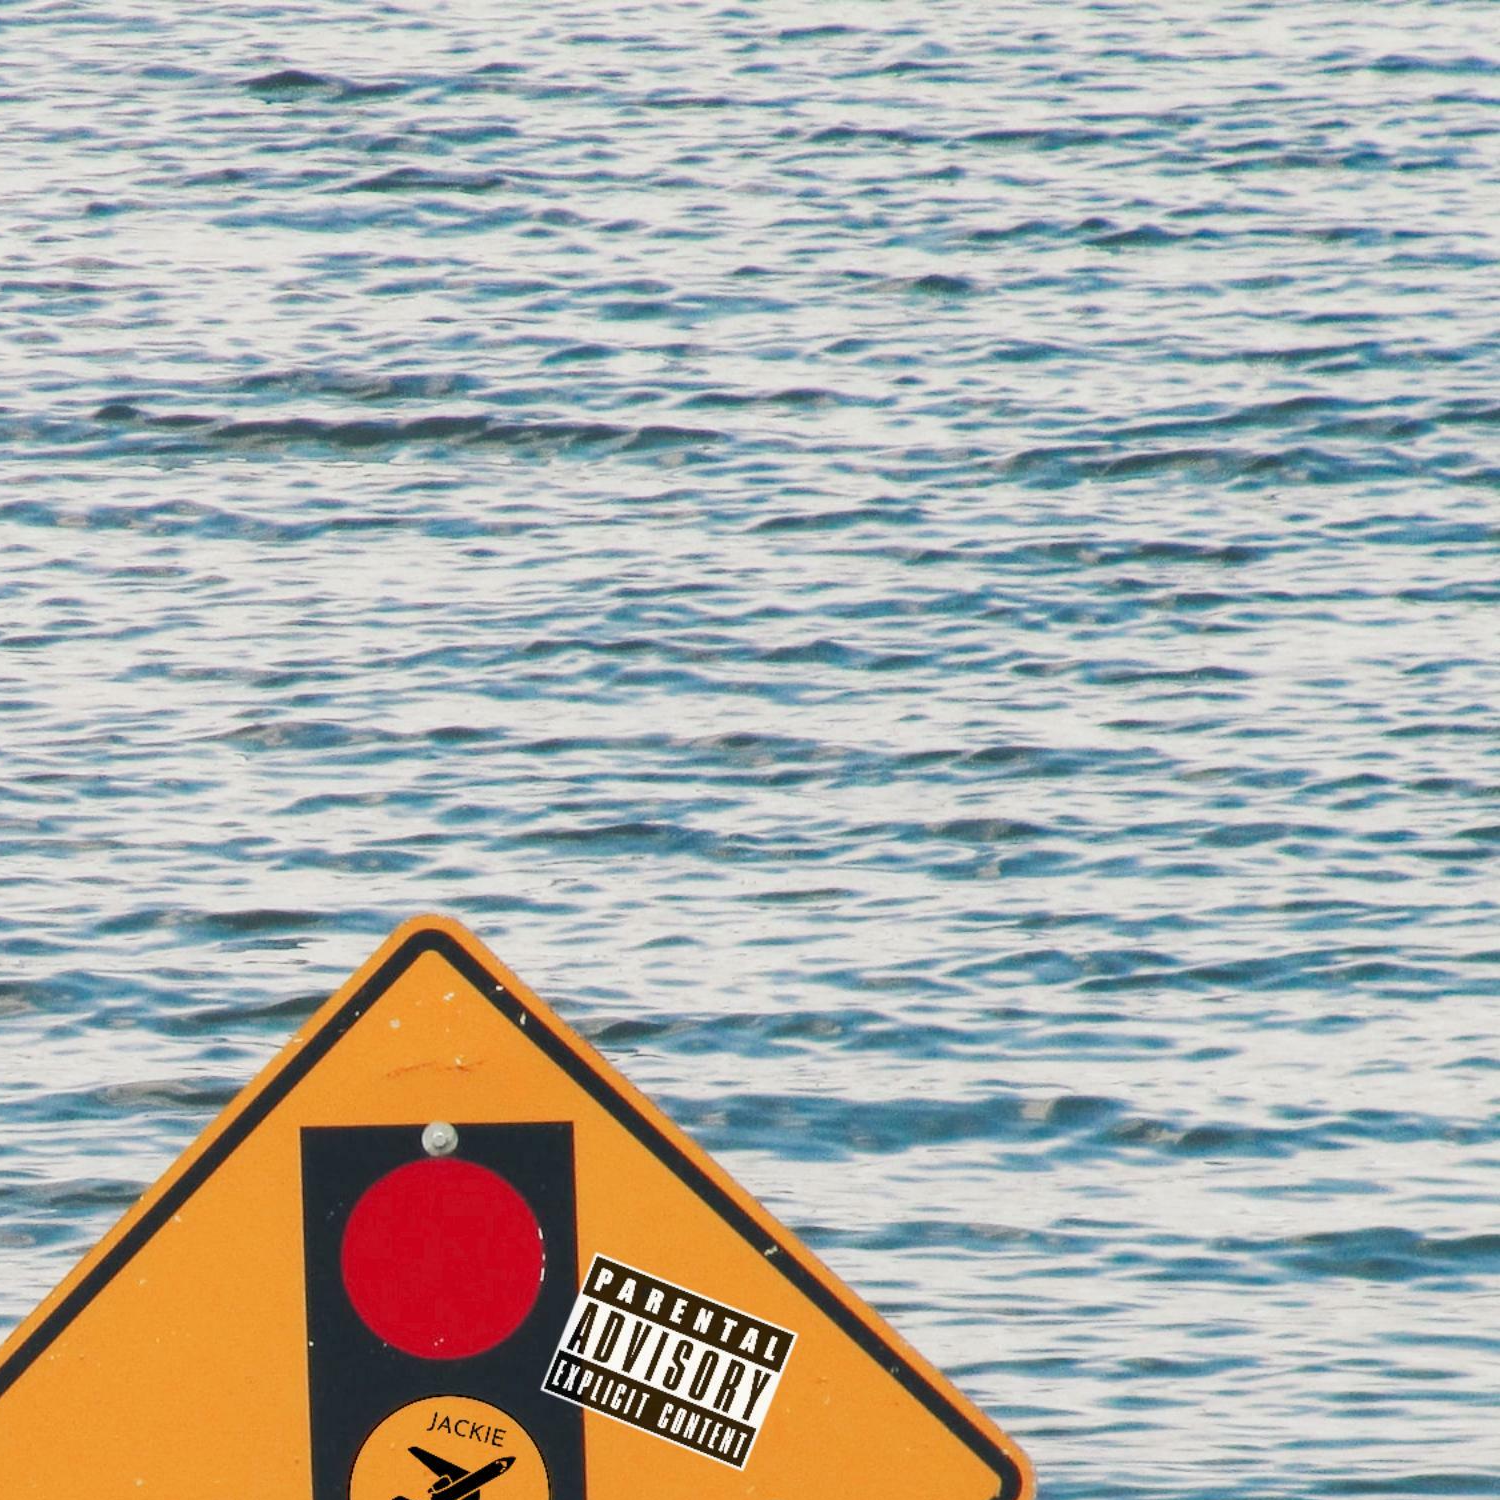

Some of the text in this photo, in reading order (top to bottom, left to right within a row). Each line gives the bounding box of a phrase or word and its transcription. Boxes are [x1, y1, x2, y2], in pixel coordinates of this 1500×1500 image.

[567, 1302, 772, 1421] ADVISORY
[594, 1267, 779, 1362] PARENTAL
[426, 1411, 508, 1448] JACKIE
[551, 1359, 748, 1459] EXPLICIT CONTENT
